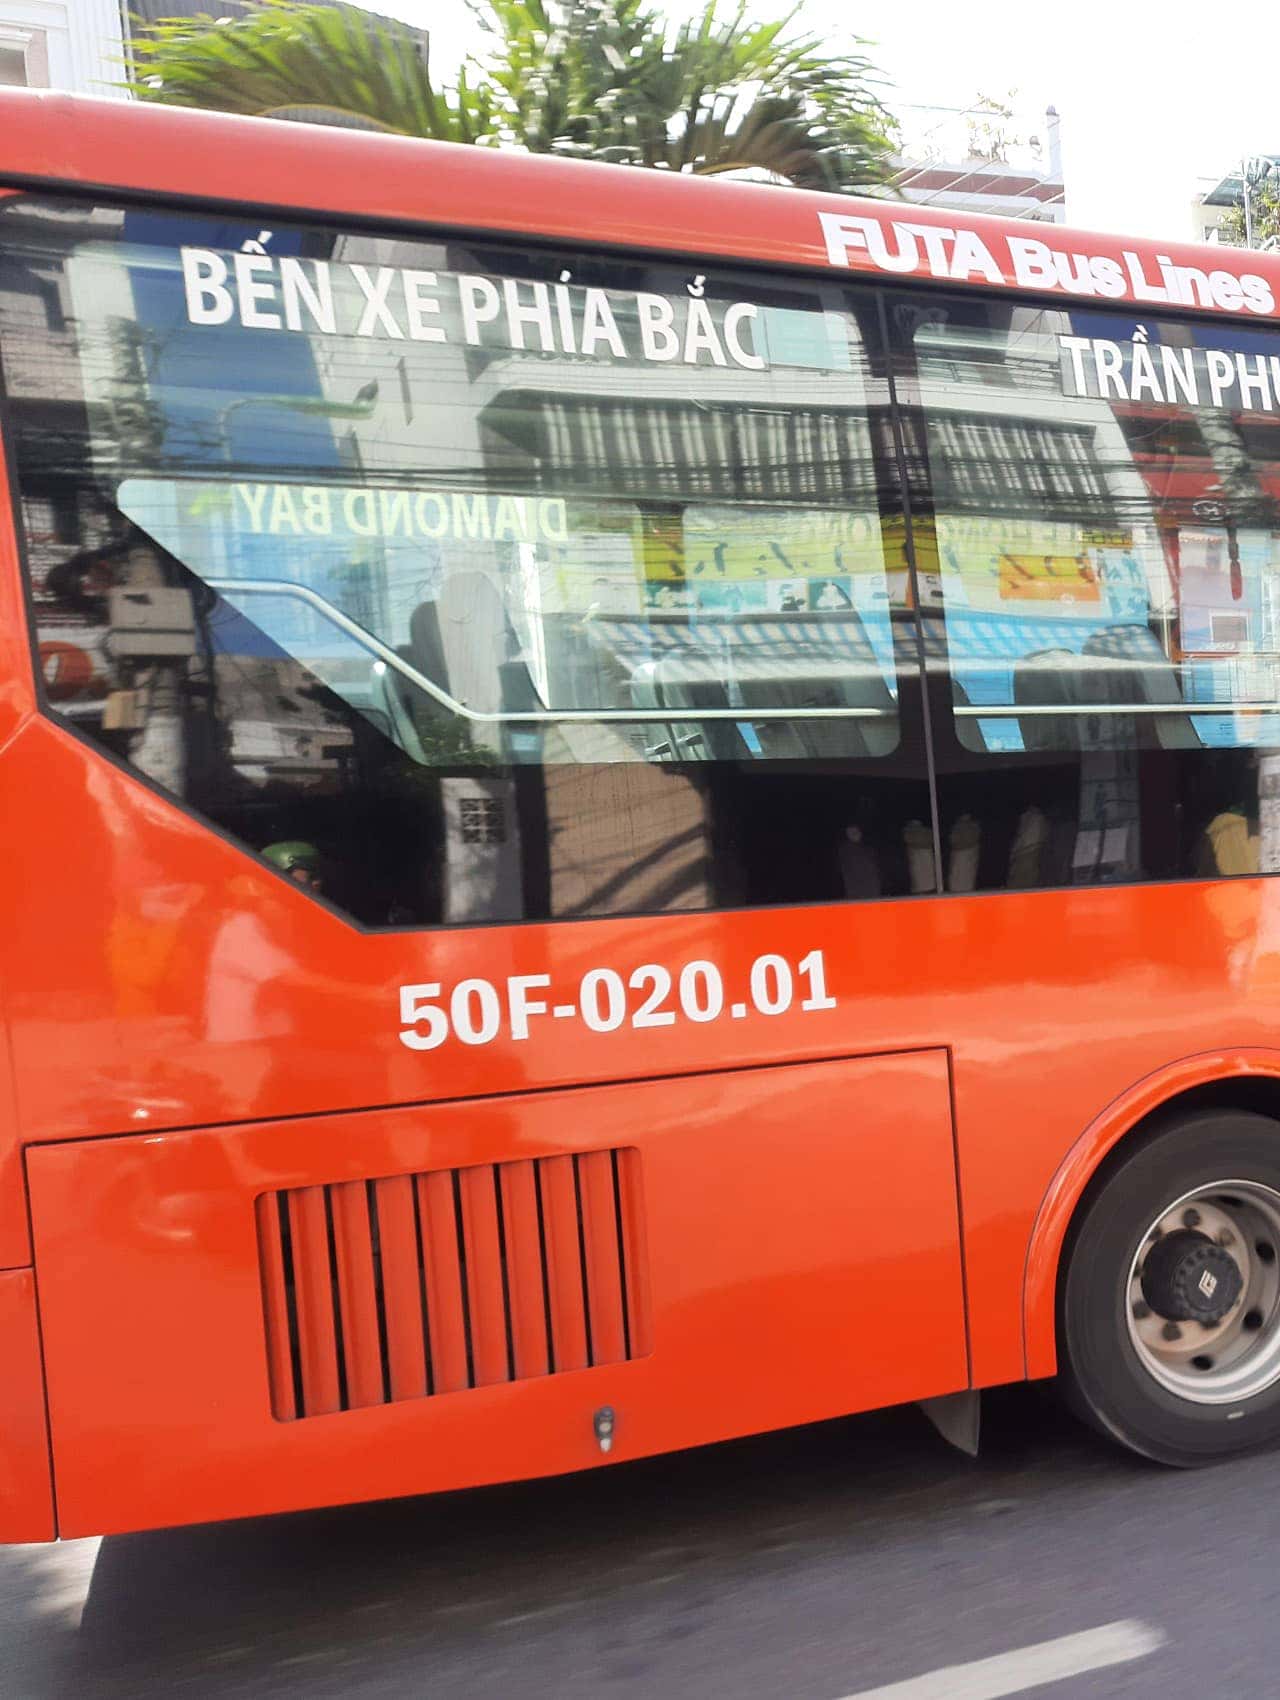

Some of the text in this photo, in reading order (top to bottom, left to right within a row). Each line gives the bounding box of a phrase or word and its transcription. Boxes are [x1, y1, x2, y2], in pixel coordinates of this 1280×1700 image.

[817, 212, 1006, 286] FUTA
[180, 230, 765, 371] BẾN XE PHÍA BẮC
[1060, 325, 1200, 407] TRẦN
[398, 949, 838, 1051] 50F-020.01
